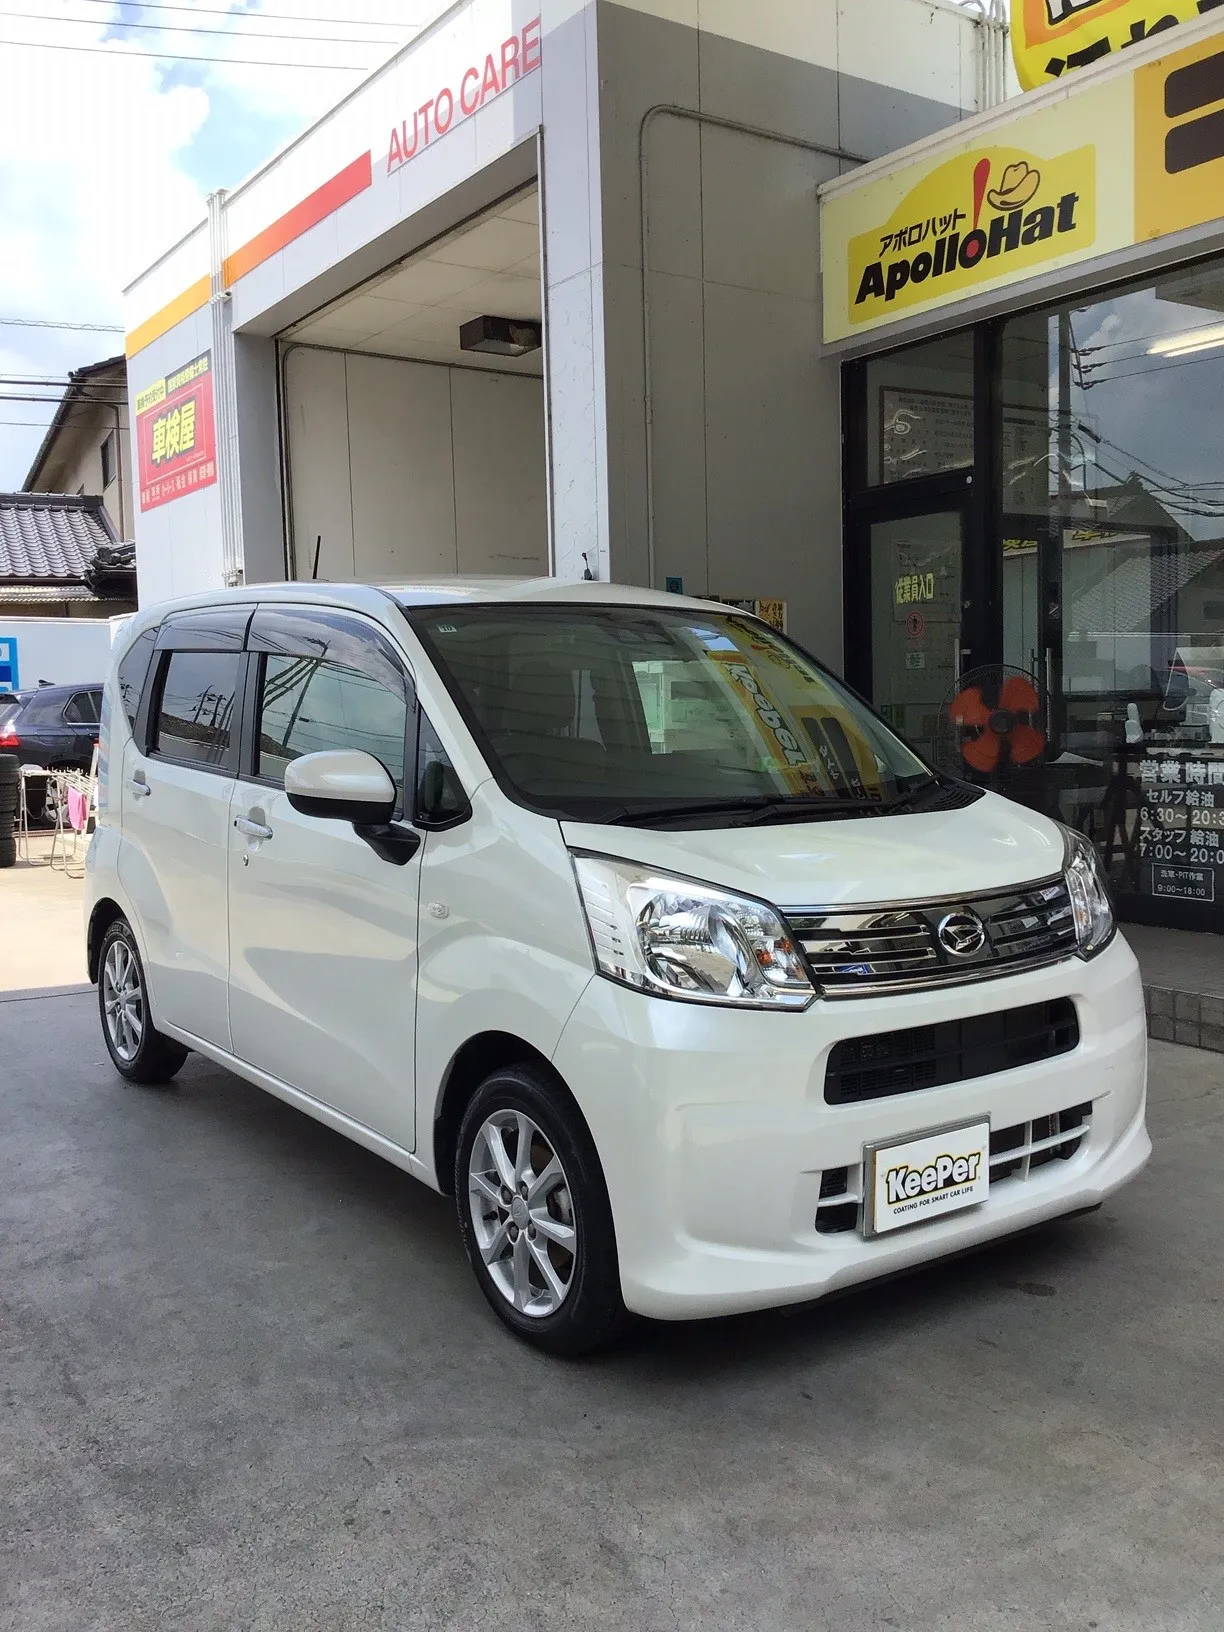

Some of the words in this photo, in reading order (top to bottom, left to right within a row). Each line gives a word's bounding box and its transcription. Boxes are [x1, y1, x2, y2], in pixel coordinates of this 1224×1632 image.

[387, 88, 453, 173] AUTO
[460, 15, 541, 116] CARE
[879, 208, 966, 258] アポロハット
[152, 400, 196, 464] 車検屋
[1139, 759, 1224, 785] 営業時間
[1146, 789, 1215, 808] セルフ給油
[1140, 826, 1219, 848] スタッフ給油
[886, 1152, 980, 1204] KeePer
[893, 1203, 918, 1214] COATING
[919, 1198, 931, 1207] FOR
[931, 1193, 949, 1204] SMART
[950, 1189, 961, 1197] CAR
[962, 1185, 974, 1194] LIFE
